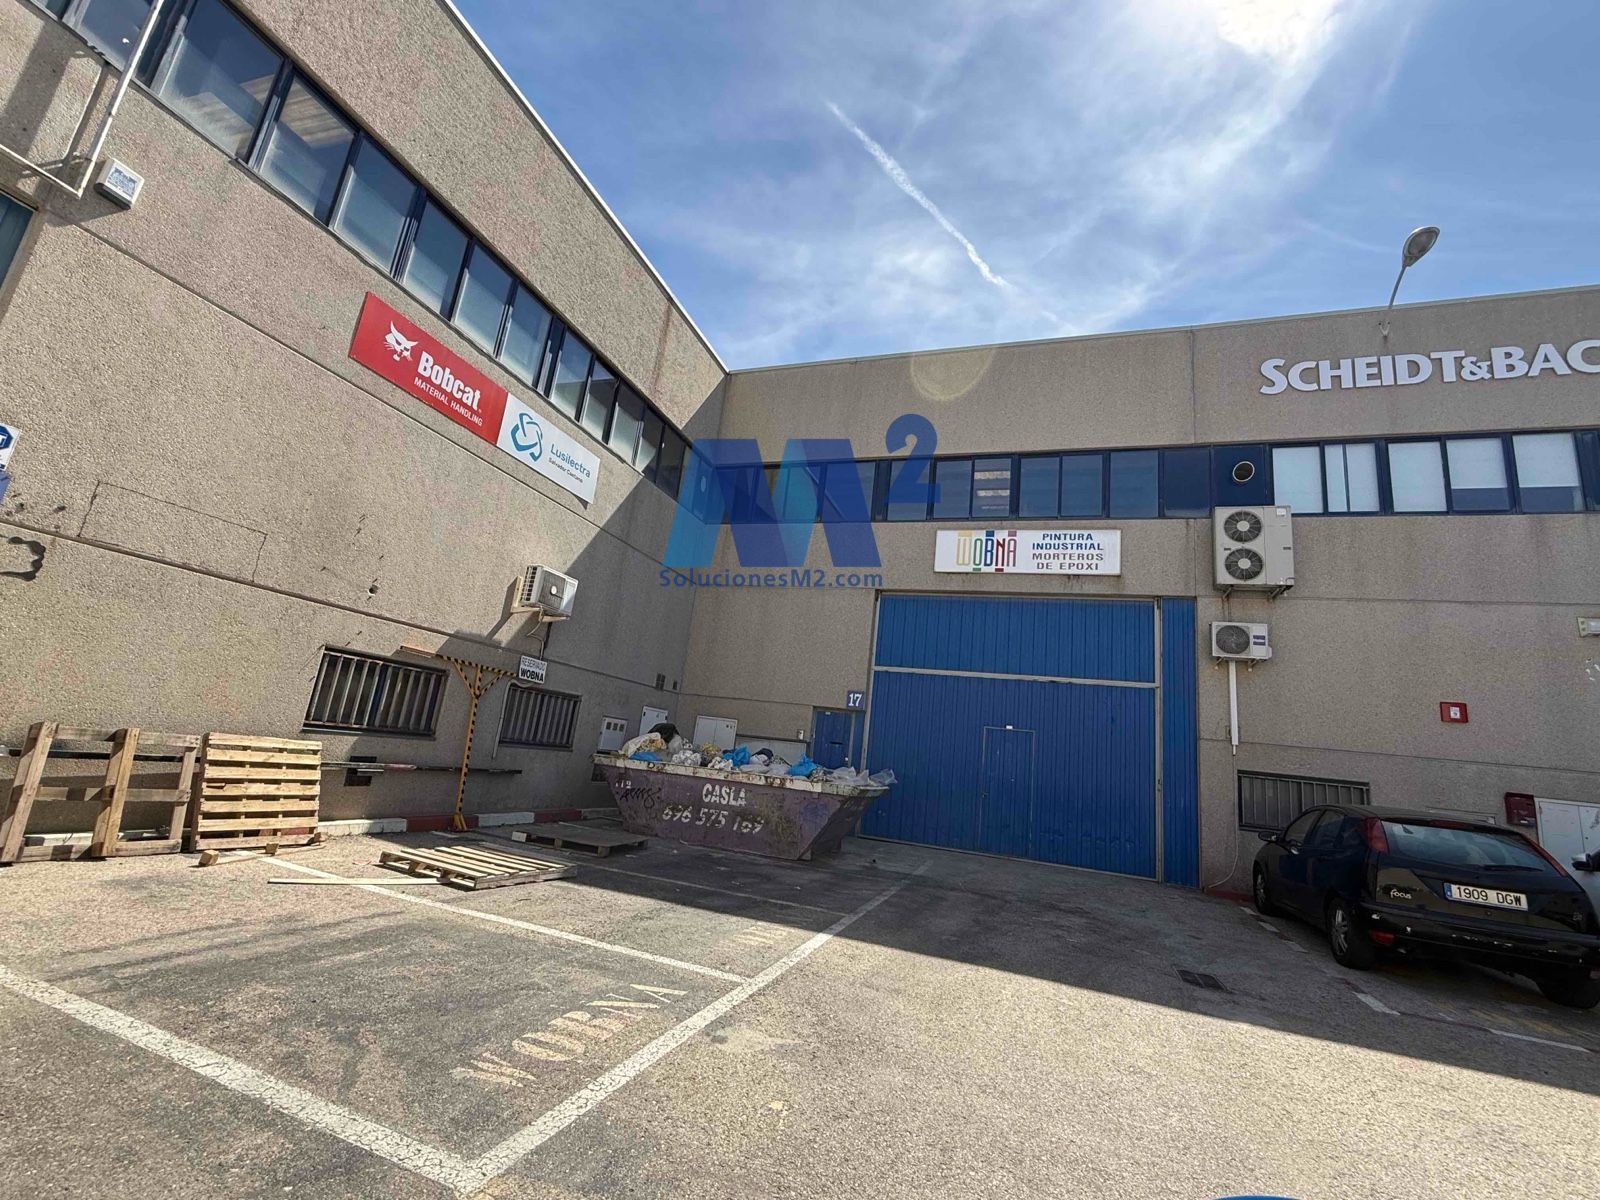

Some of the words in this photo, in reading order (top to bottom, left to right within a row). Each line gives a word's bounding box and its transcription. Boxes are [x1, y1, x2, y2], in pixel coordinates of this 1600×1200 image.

[417, 350, 481, 411] Bobcat
[413, 376, 449, 406] MATERIAL
[450, 400, 483, 426] HANDLING
[550, 443, 591, 478] Lusilectra
[1042, 533, 1093, 541] PINTURA
[1032, 542, 1104, 551] INDUSTRIAL
[1032, 552, 1104, 561] MORTEROS
[1036, 562, 1053, 570] DE
[1059, 562, 1099, 571] EPOXI
[520, 667, 544, 682] WOBNA
[848, 693, 863, 707] 17
[702, 783, 747, 807] CASLA
[1457, 886, 1488, 901] 1909
[1496, 892, 1522, 907] DGW
